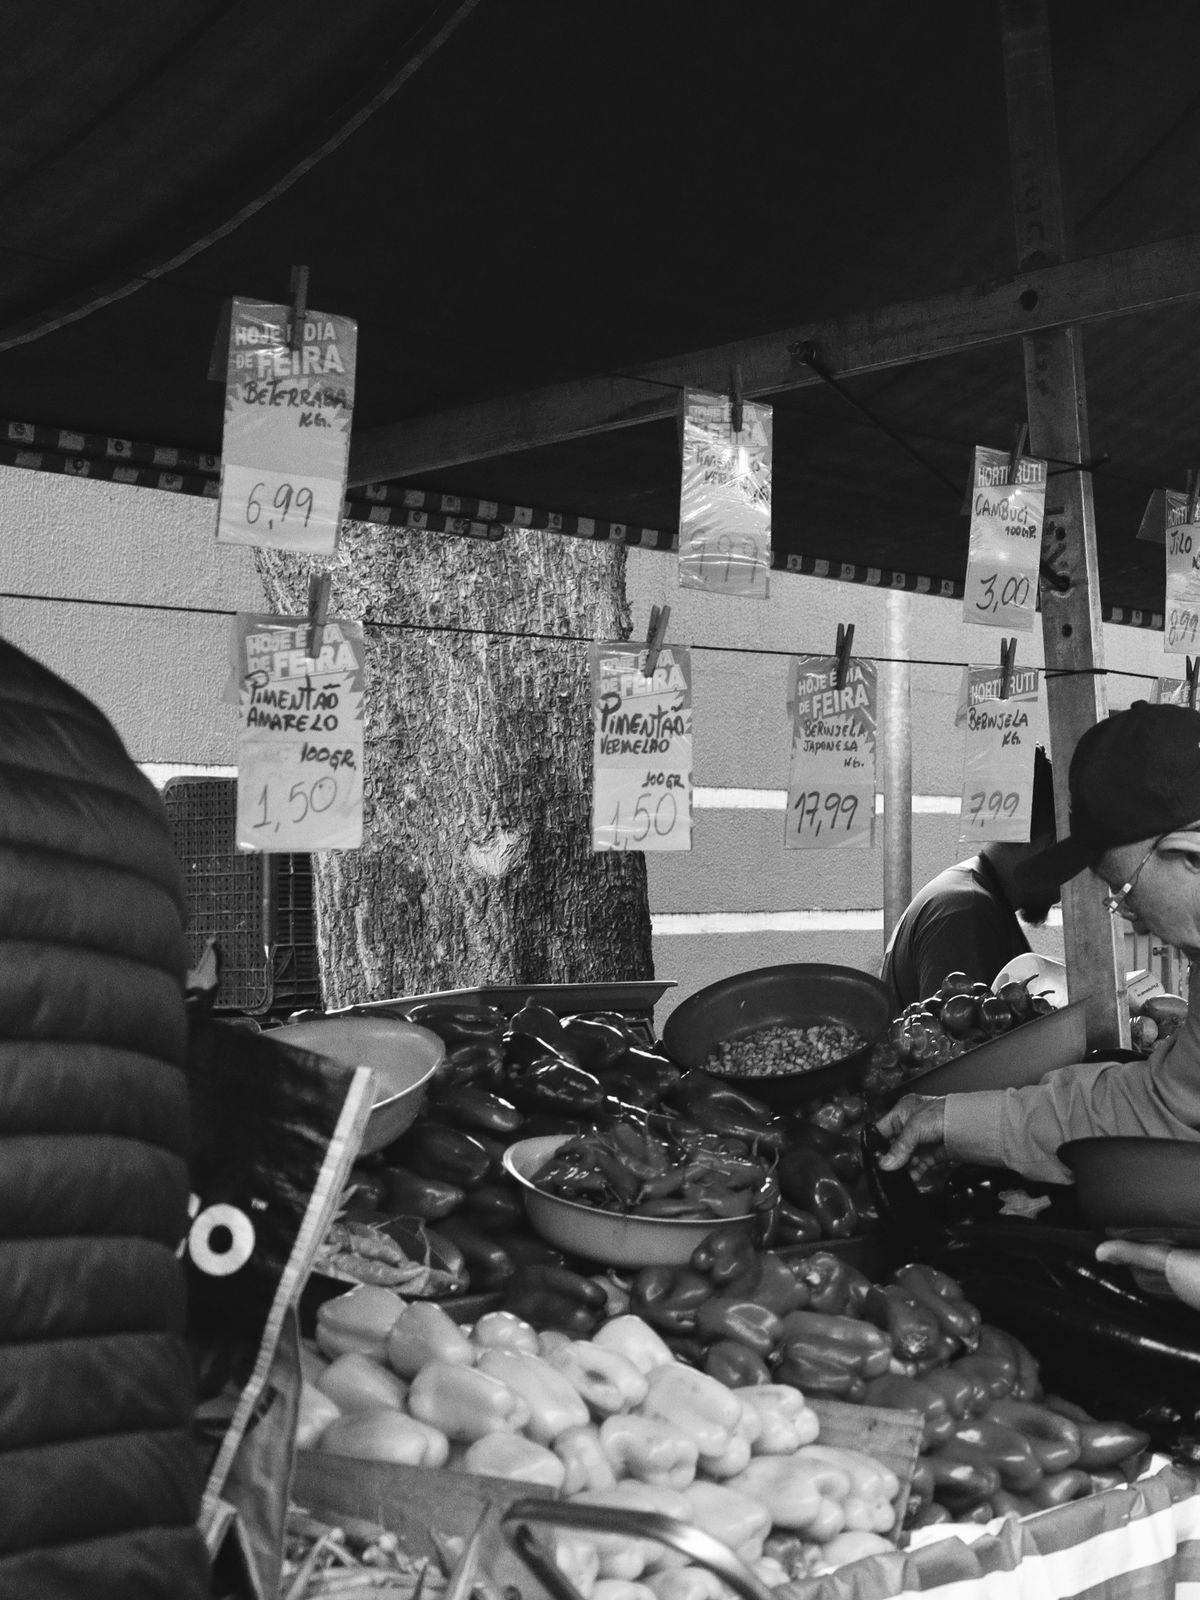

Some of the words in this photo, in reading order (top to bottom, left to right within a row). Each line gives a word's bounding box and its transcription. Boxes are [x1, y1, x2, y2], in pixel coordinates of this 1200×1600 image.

[235, 323, 281, 346] HOJE
[303, 321, 337, 342] DIA
[236, 353, 253, 369] DE
[257, 344, 345, 378] FEIRA
[243, 379, 349, 407] BETERRABA
[978, 463, 1042, 487] HORTIRUTI
[246, 482, 315, 530] 6,99
[975, 493, 1029, 526] CAMBUCI
[975, 573, 1031, 614] 3,00
[273, 640, 359, 677] FEIRA
[245, 670, 341, 712] PIMENTÃO
[799, 676, 827, 697] HOJE
[799, 701, 811, 715] DE
[812, 684, 869, 720] FEIRA
[971, 671, 1036, 706] HORTIRUTI
[247, 707, 339, 732] AMARELO
[599, 692, 685, 740] PIMENTÃO
[600, 735, 671, 756] VERMELHO
[803, 739, 859, 757] JAPONESA
[253, 777, 337, 833] 1,50
[795, 791, 859, 838] 17,99
[970, 790, 1021, 828] 7,99
